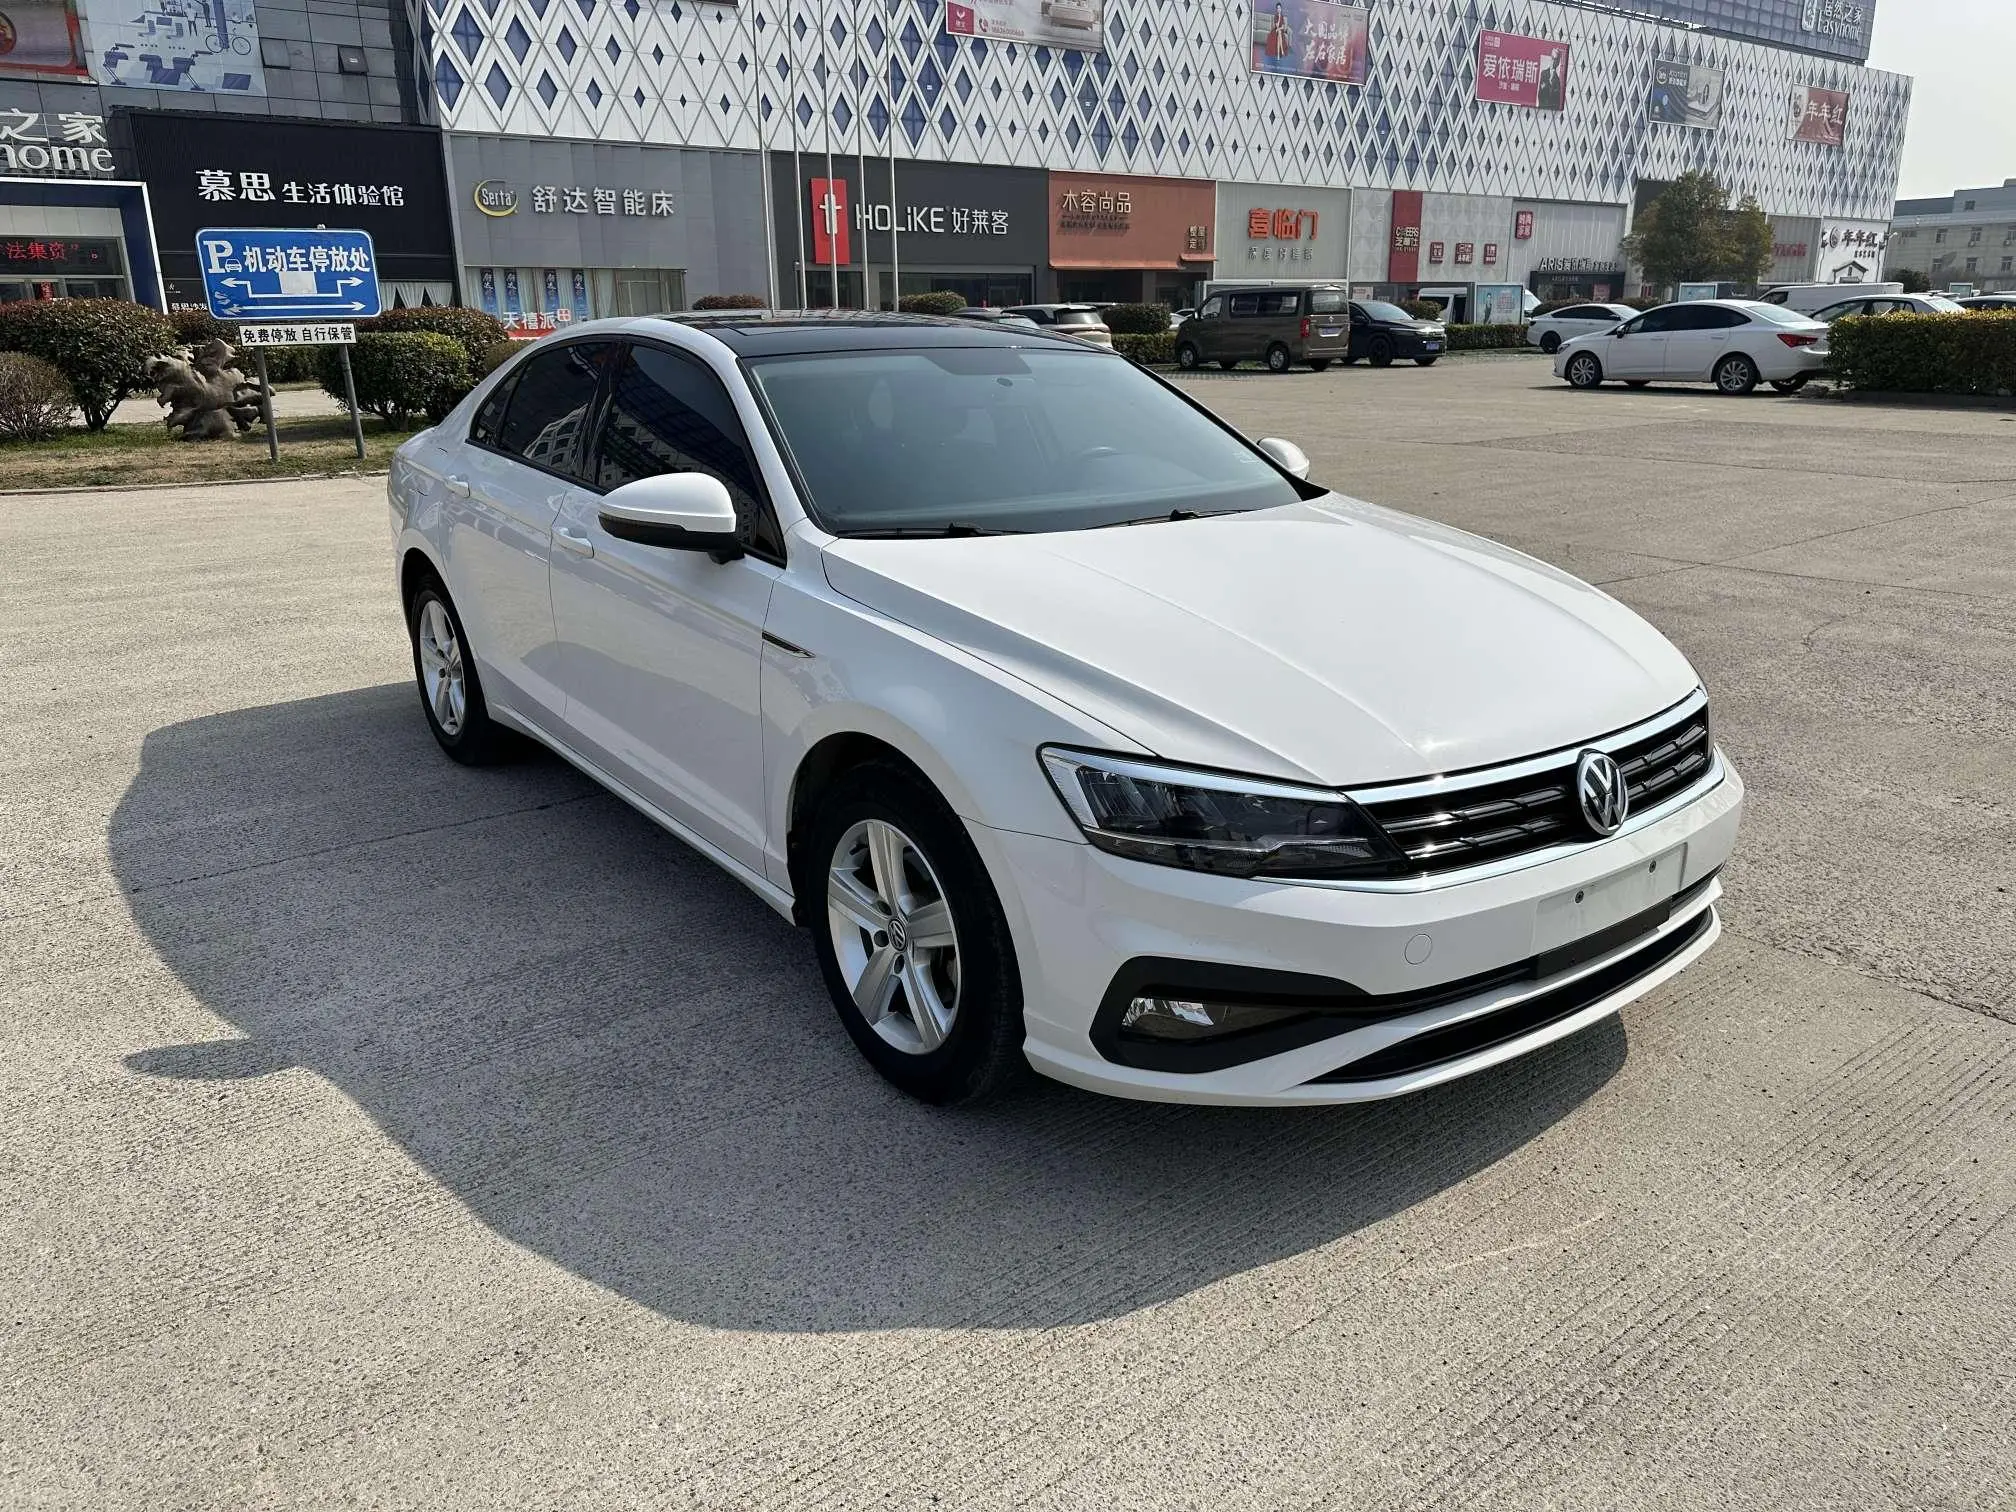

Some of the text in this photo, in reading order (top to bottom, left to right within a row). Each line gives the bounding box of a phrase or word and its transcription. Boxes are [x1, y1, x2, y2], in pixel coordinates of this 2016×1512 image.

[1482, 54, 1538, 84] 爱依瑞斯
[0, 107, 107, 143] 之家
[196, 169, 404, 206] 慕思 生活体验馆
[481, 187, 513, 206] Serta
[532, 184, 675, 217] 舒达智能床
[1062, 189, 1132, 213] 木容尚品
[951, 207, 1009, 235] 好莱客
[1247, 208, 1319, 240] 喜临门
[243, 246, 370, 273] 机动车停放处
[243, 326, 352, 343] 免费停放 自行保管
